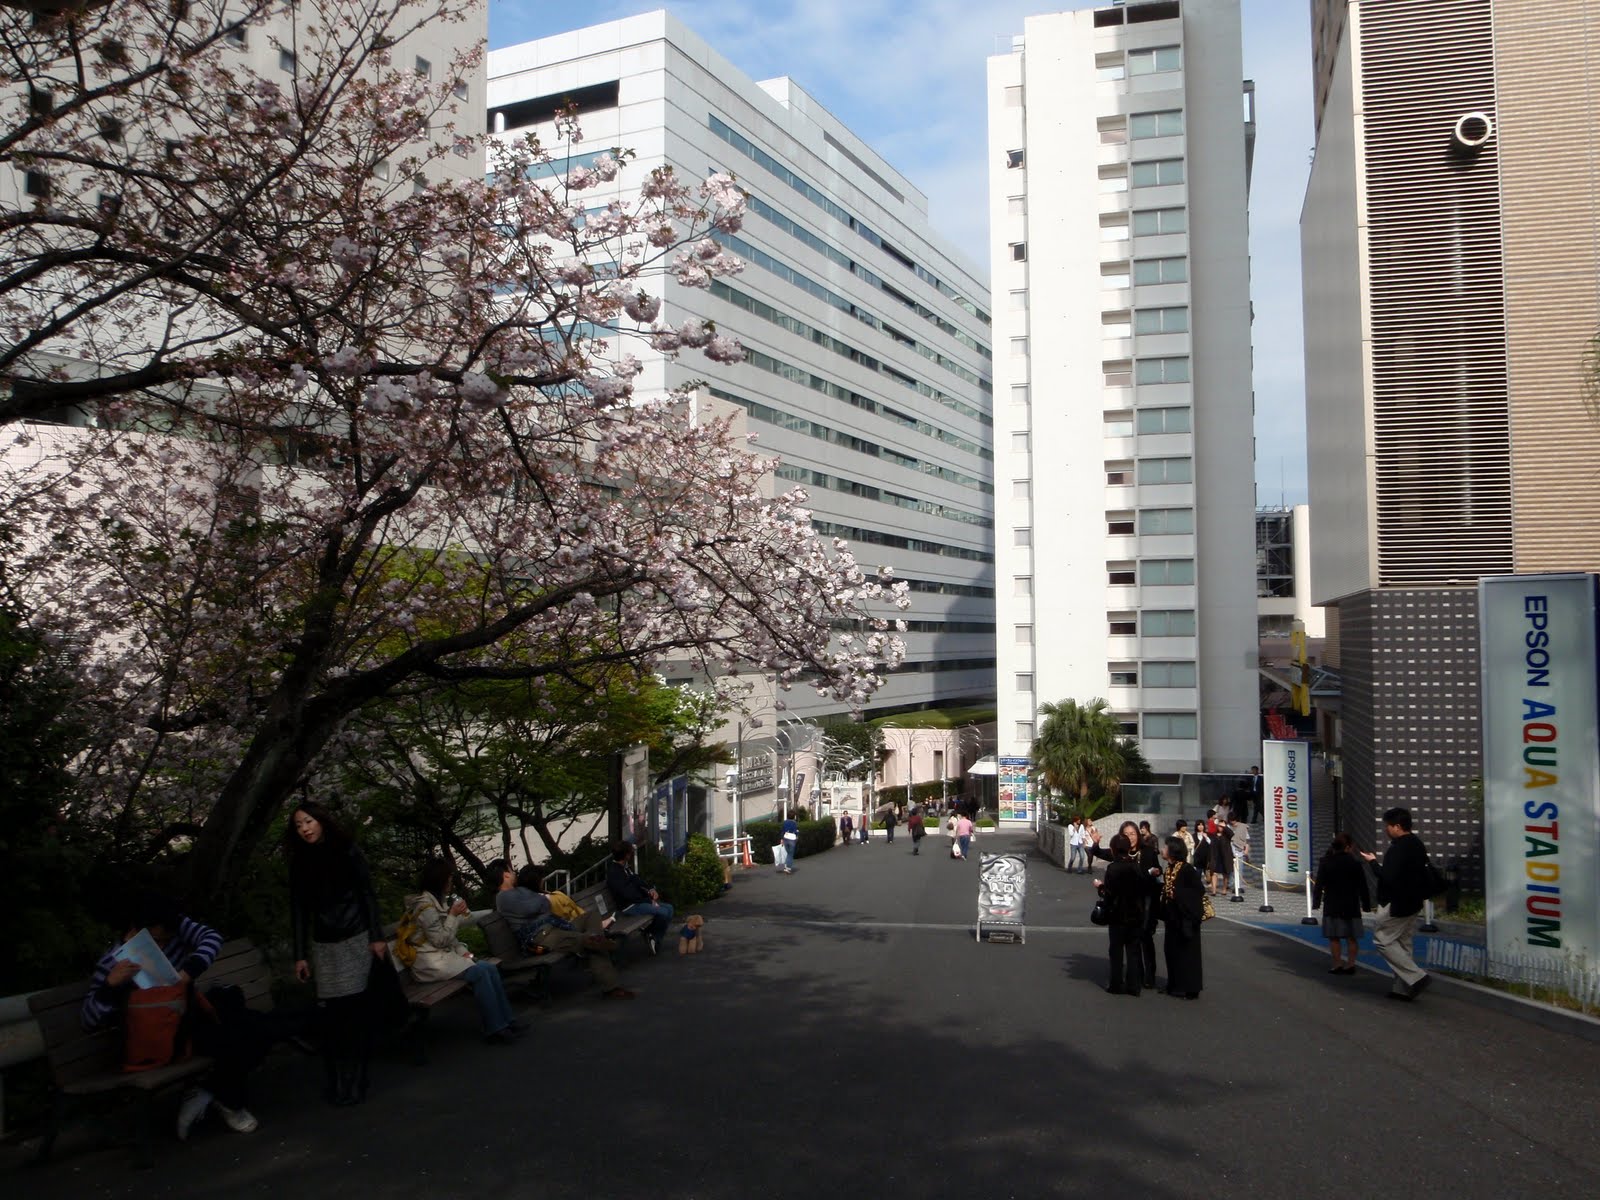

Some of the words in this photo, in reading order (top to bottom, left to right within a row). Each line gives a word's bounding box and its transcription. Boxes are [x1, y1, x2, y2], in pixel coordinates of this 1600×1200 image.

[1524, 595, 1550, 687] EPSON
[1287, 750, 1296, 782] EPSON
[1522, 698, 1558, 789] AQUA
[1286, 786, 1298, 817] AQUA
[1287, 821, 1299, 873] STADIUM
[1524, 801, 1561, 949] STADIUM
